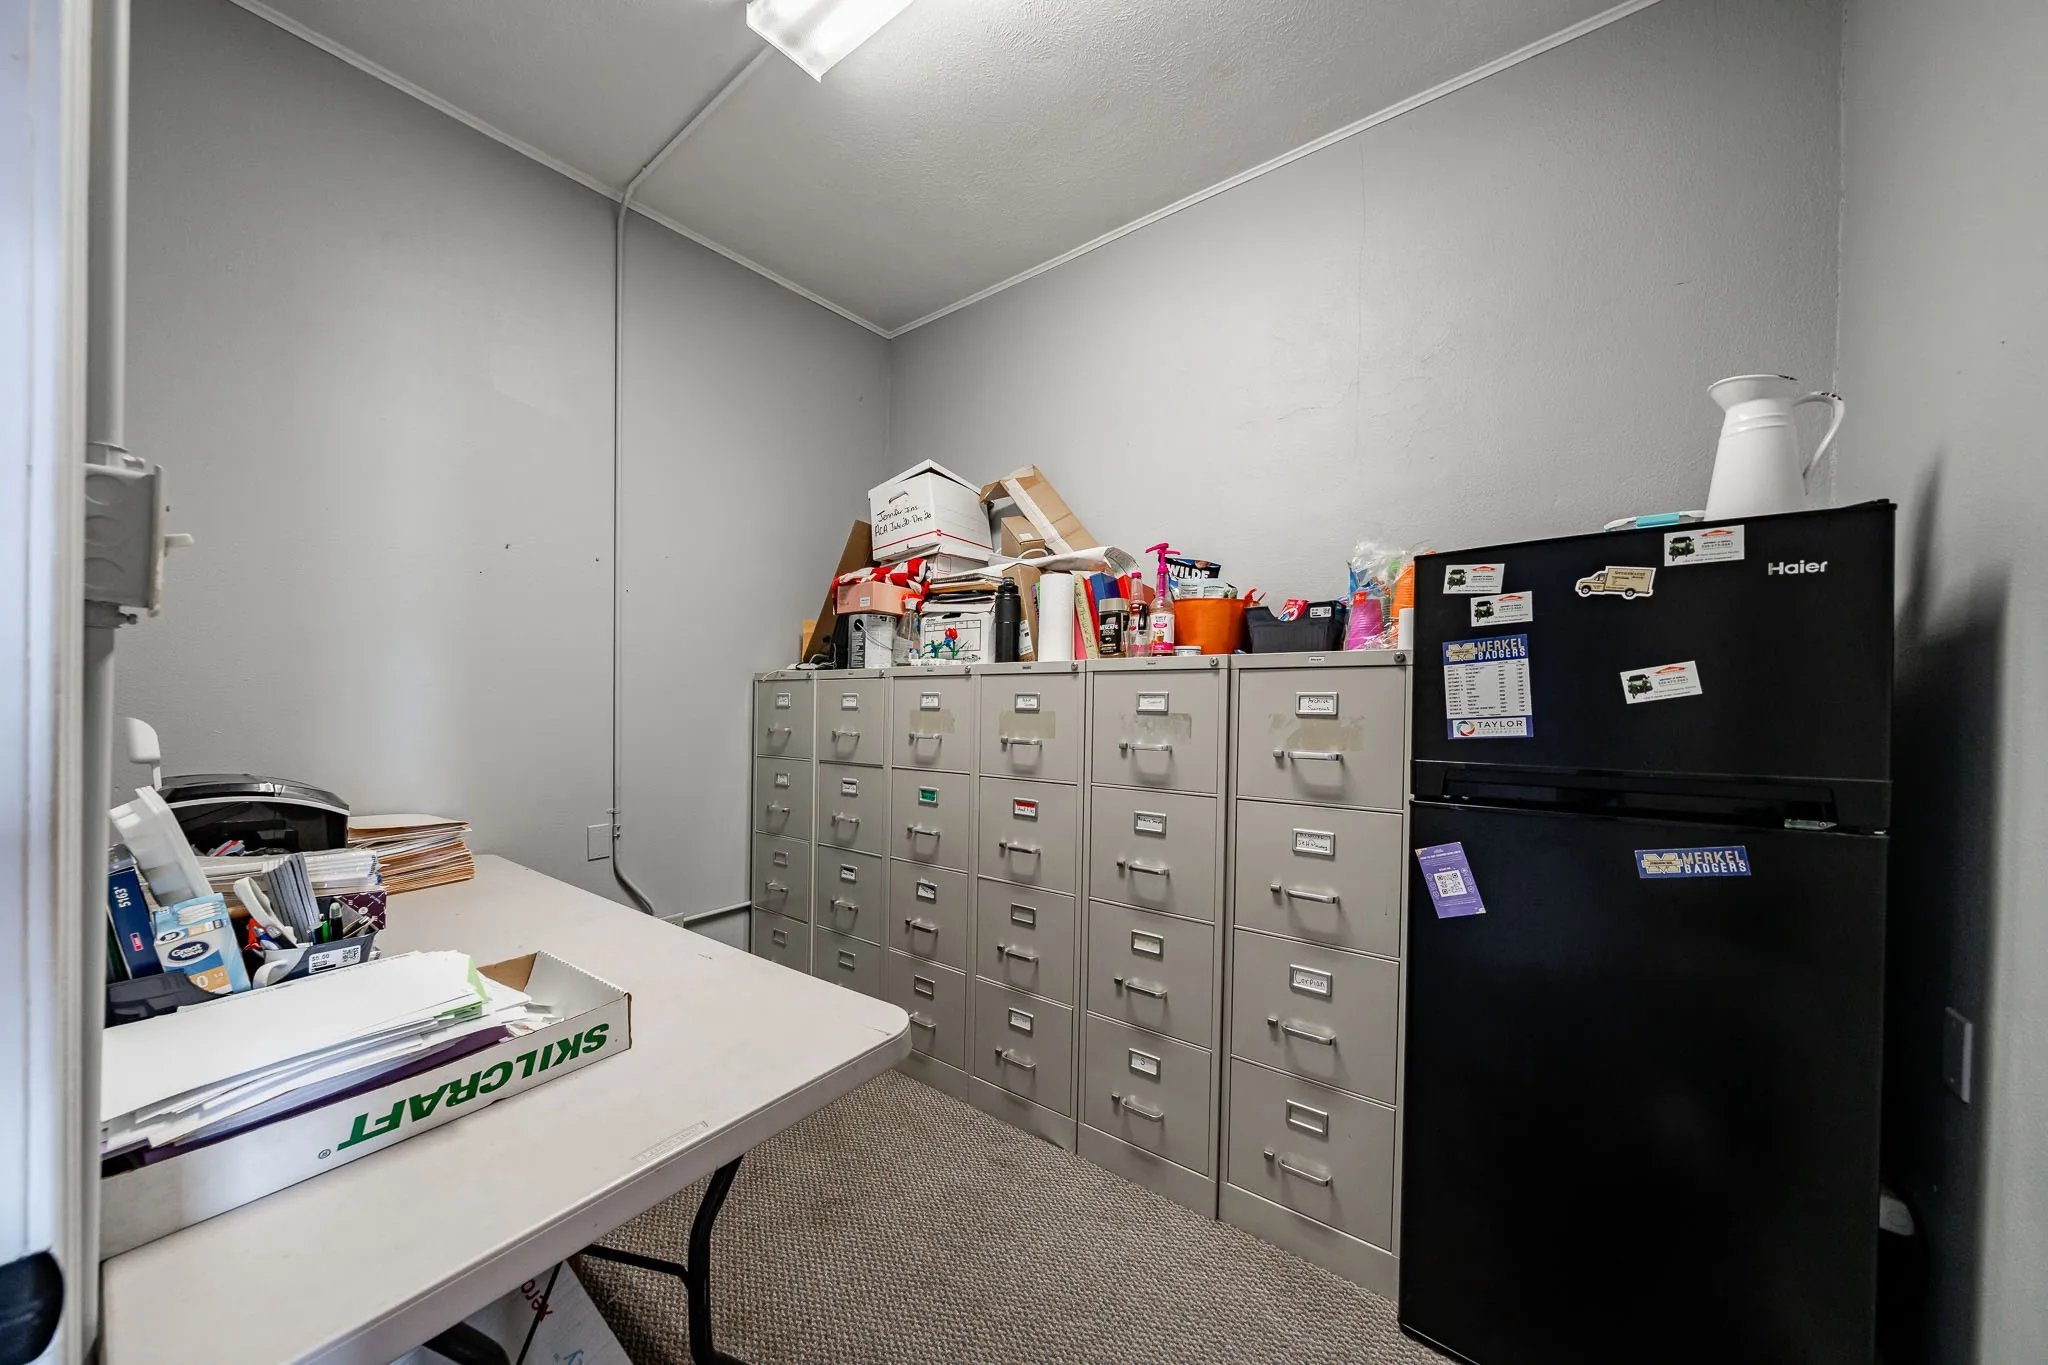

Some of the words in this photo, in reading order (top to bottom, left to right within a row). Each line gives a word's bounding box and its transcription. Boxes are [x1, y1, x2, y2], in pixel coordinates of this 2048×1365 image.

[1167, 563, 1210, 580] WILDE
[1768, 560, 1828, 575] Haier
[1477, 638, 1523, 652] MERKEL
[1478, 646, 1526, 660] BADGERS
[1477, 720, 1523, 728] TAYLOR
[1682, 850, 1745, 865] MERKEL
[1684, 862, 1747, 874] BADGERS
[337, 1023, 609, 1152] SKILCRAFT
